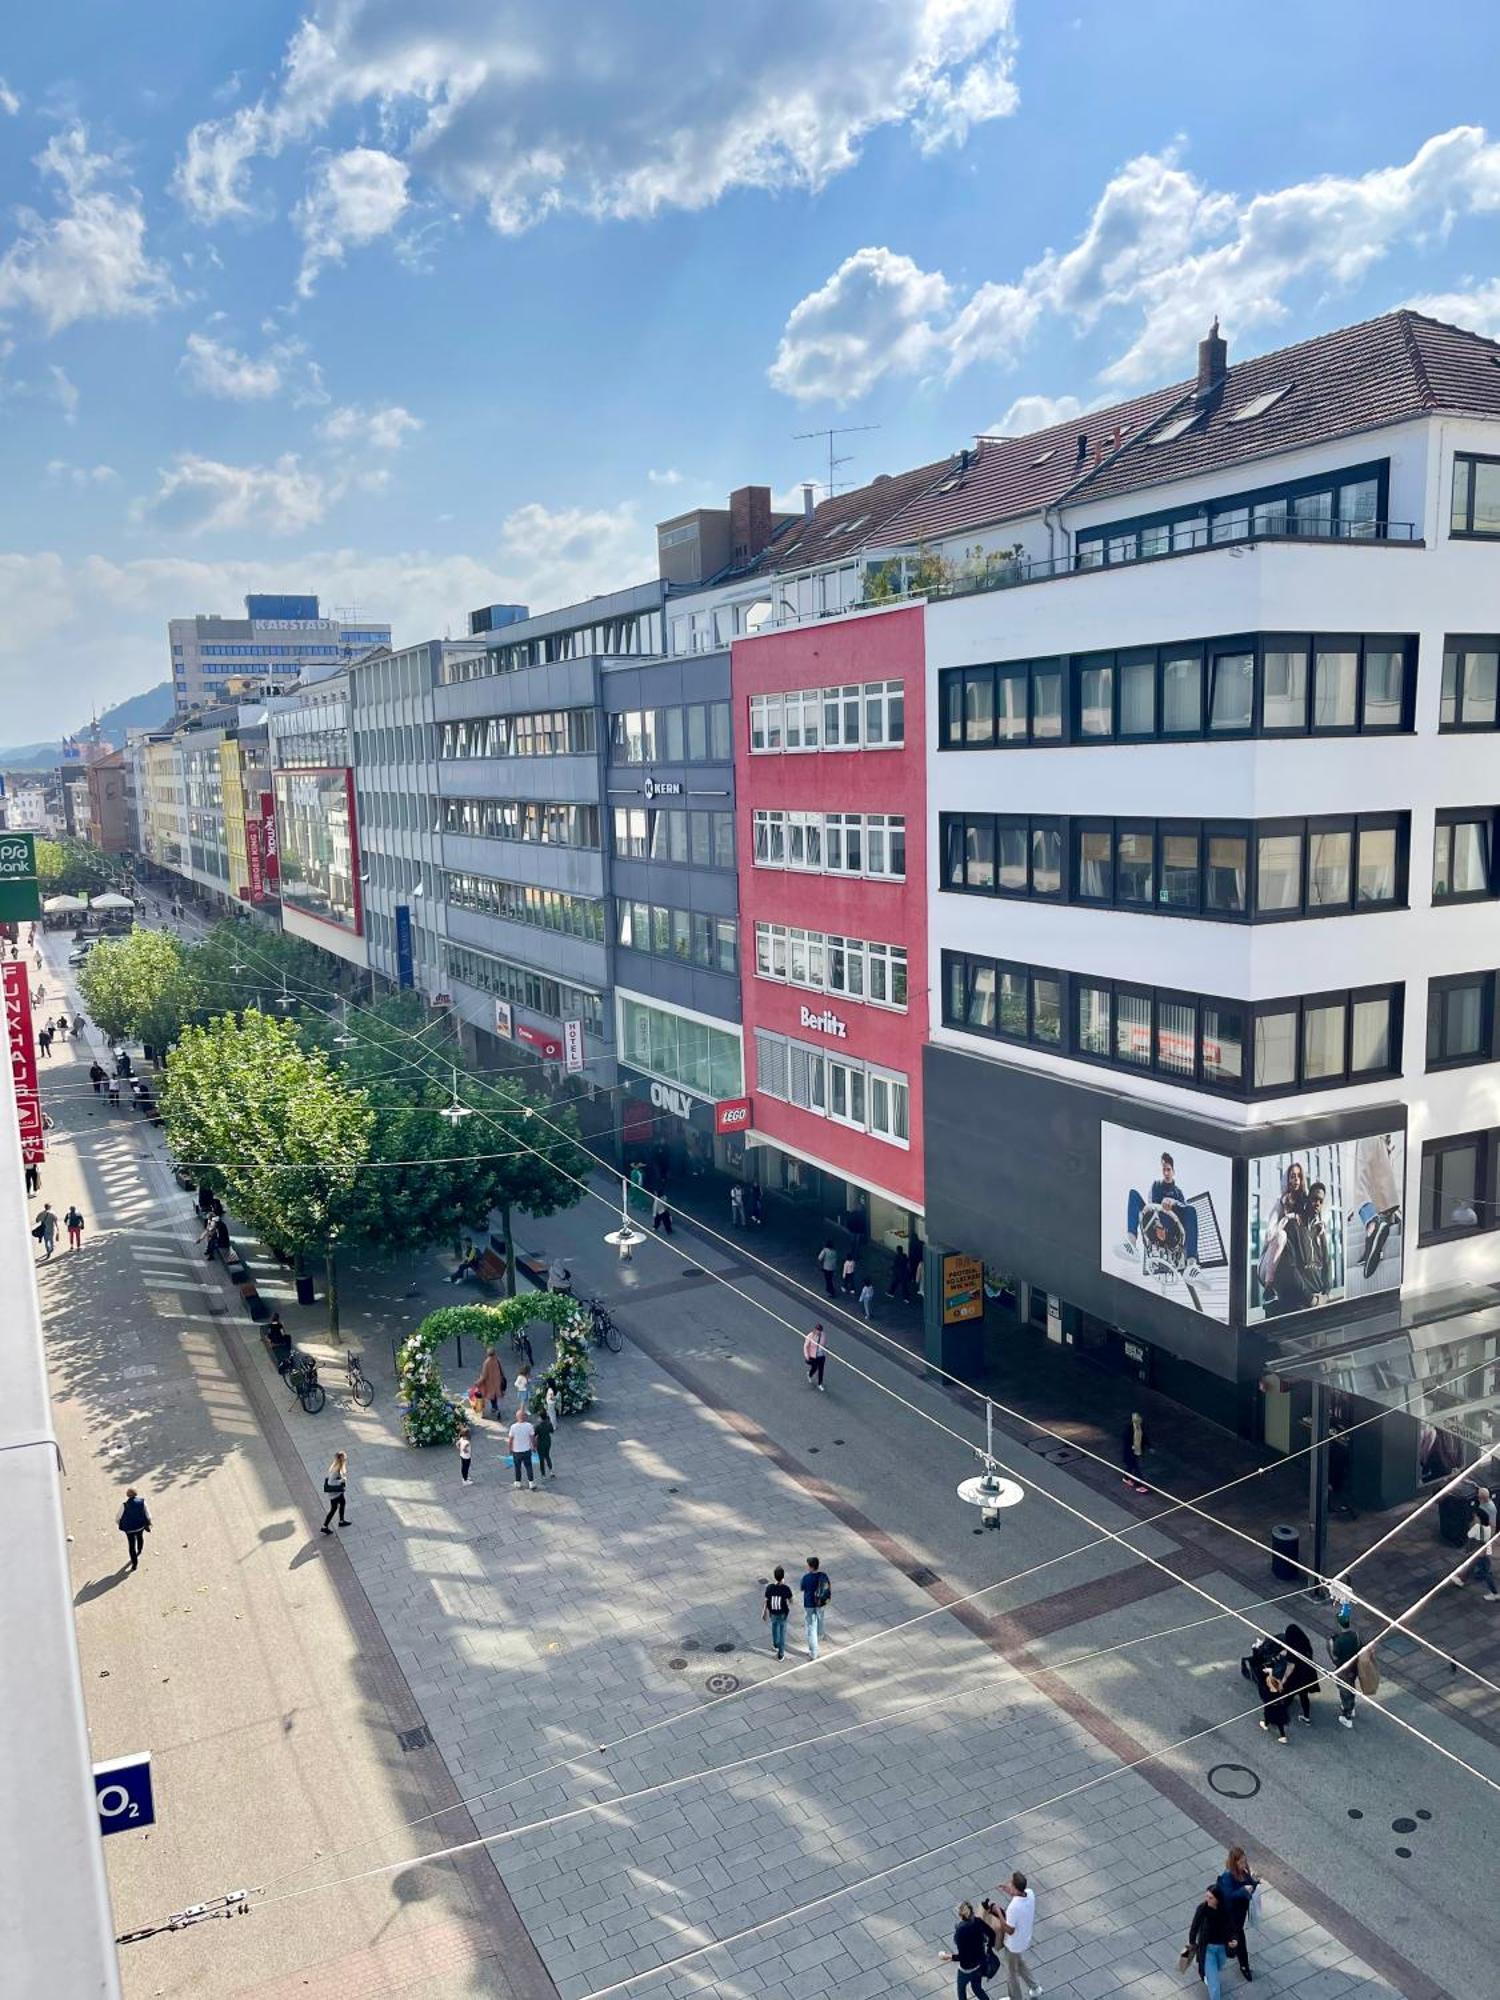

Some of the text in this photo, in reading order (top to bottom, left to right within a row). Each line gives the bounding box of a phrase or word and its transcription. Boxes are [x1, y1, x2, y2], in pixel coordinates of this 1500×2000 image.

[255, 619, 335, 631] KARSTADT
[654, 783, 680, 794] KERN
[250, 834, 258, 855] KING
[0, 861, 30, 872] ank
[800, 1006, 846, 1038] Berlitz
[568, 1023, 577, 1060] HOTEL
[650, 1082, 692, 1119] ONLY
[723, 1109, 746, 1124] LEGO
